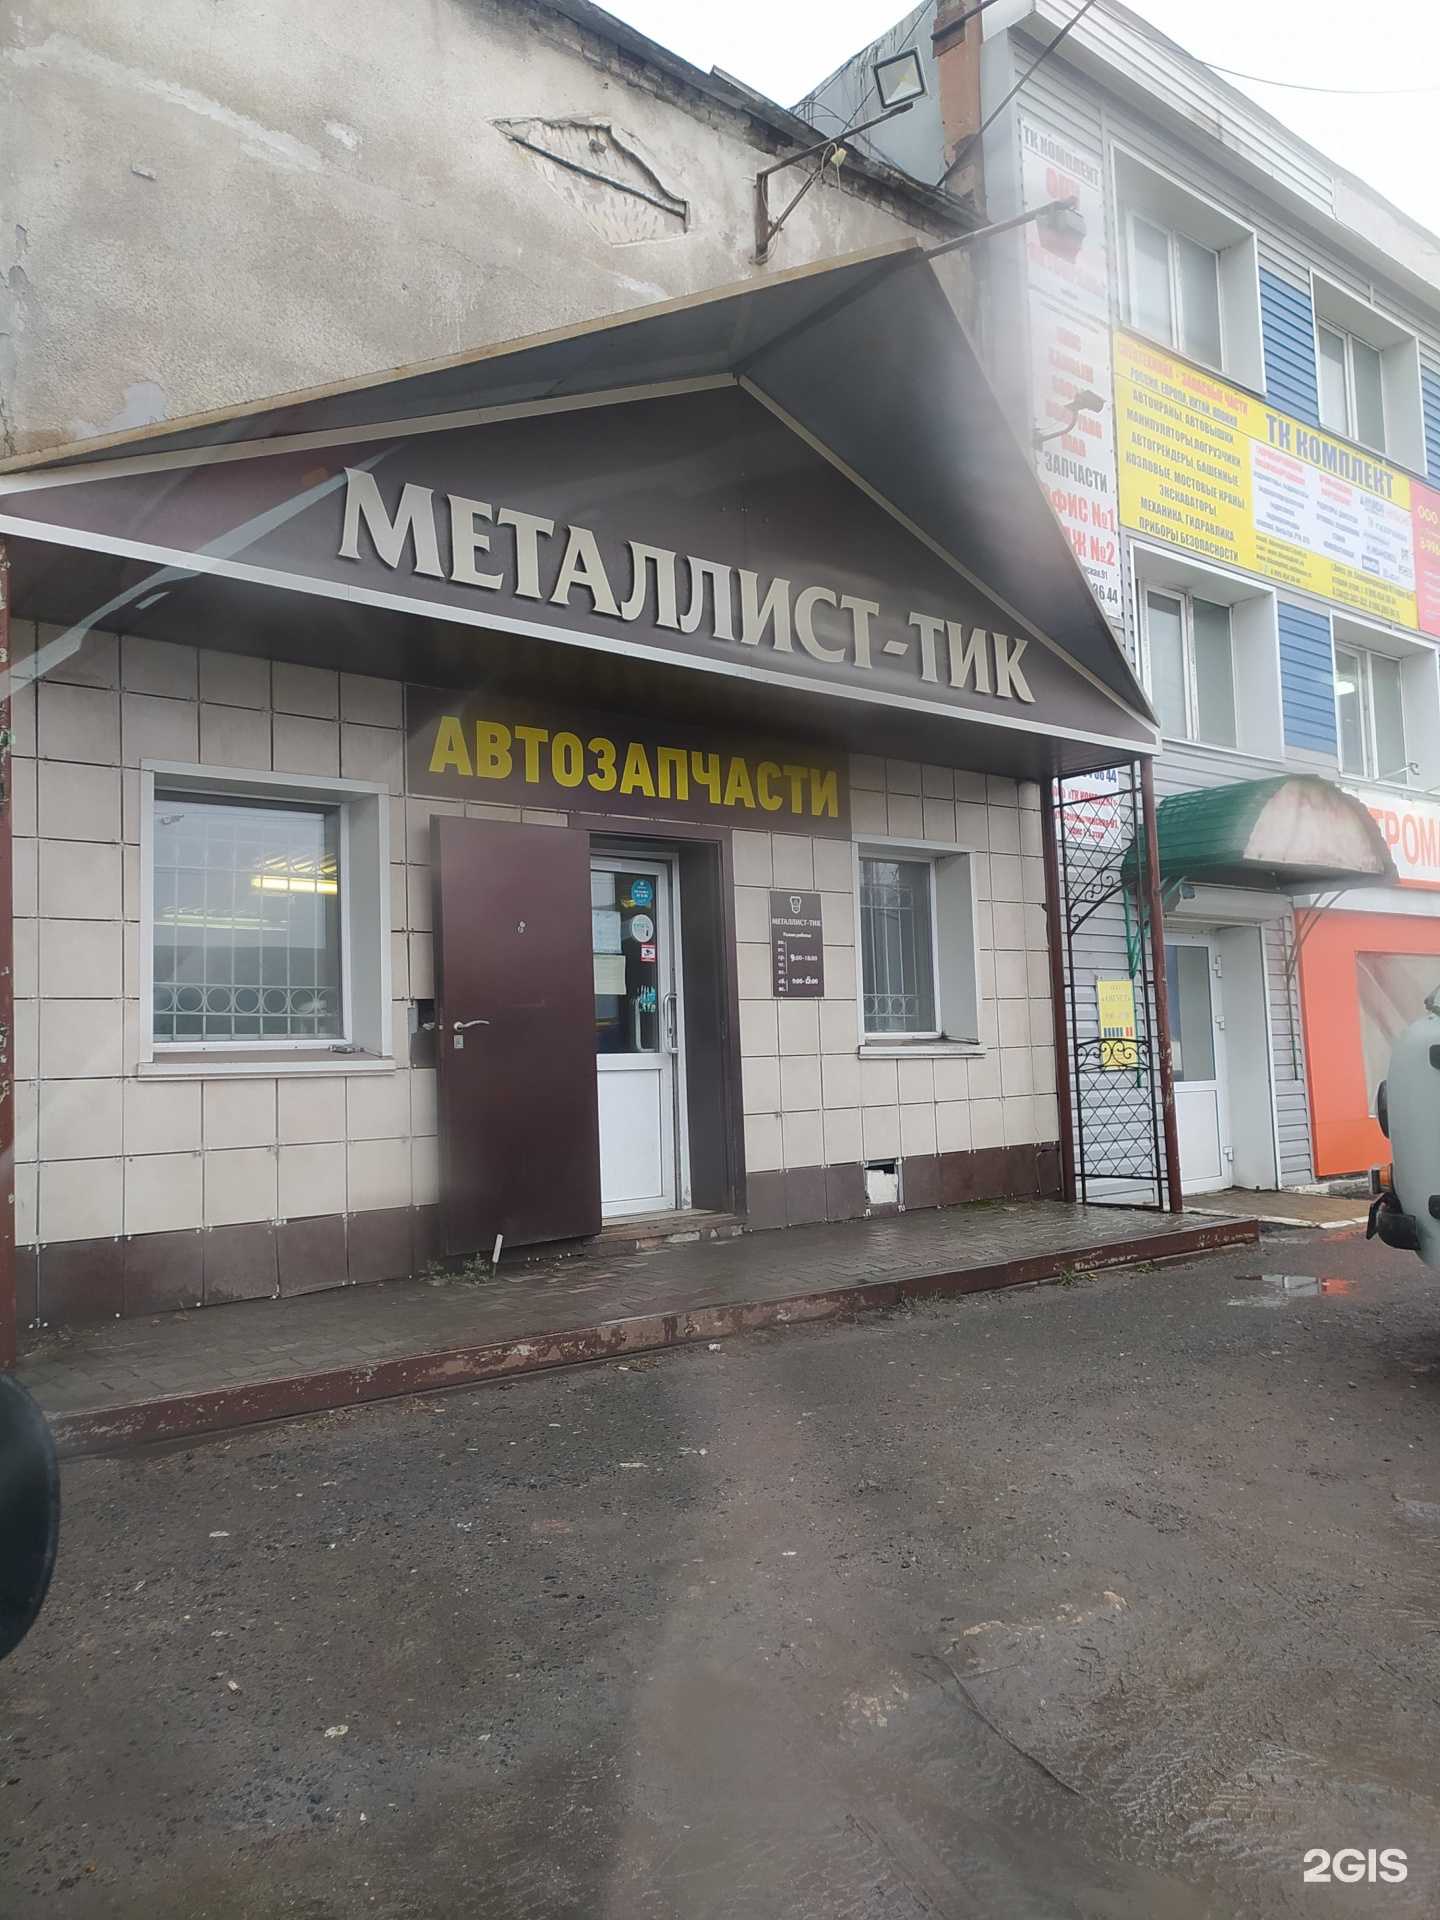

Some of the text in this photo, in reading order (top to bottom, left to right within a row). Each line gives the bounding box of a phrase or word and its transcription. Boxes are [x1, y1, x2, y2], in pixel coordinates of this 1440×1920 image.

[1044, 451, 1107, 493] ЗАПЧАСТИ
[1266, 413, 1290, 450] ТК
[1295, 428, 1393, 498] КОМПЛЕКТ
[339, 467, 1036, 704] МЕТАЛЛИСТ-ТИК
[428, 715, 840, 819] АВТОЗАПЧАСТИ
